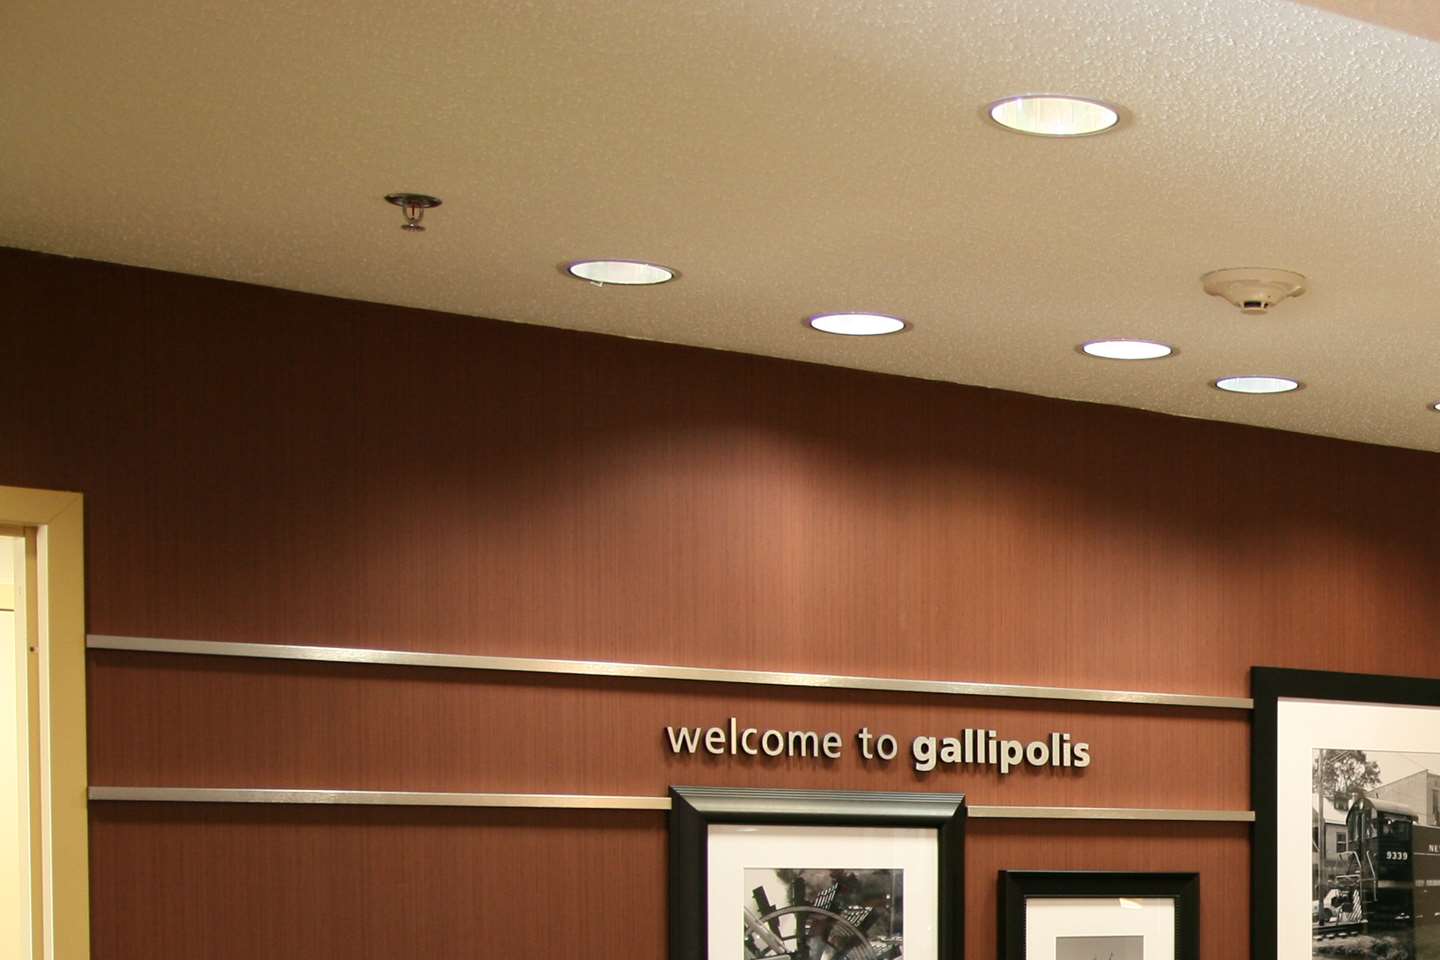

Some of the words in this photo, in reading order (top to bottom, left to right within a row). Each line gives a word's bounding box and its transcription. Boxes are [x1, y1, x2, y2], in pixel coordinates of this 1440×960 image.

[665, 717, 843, 760] welcome
[858, 726, 898, 761] to
[912, 728, 1091, 774] gallipolis
